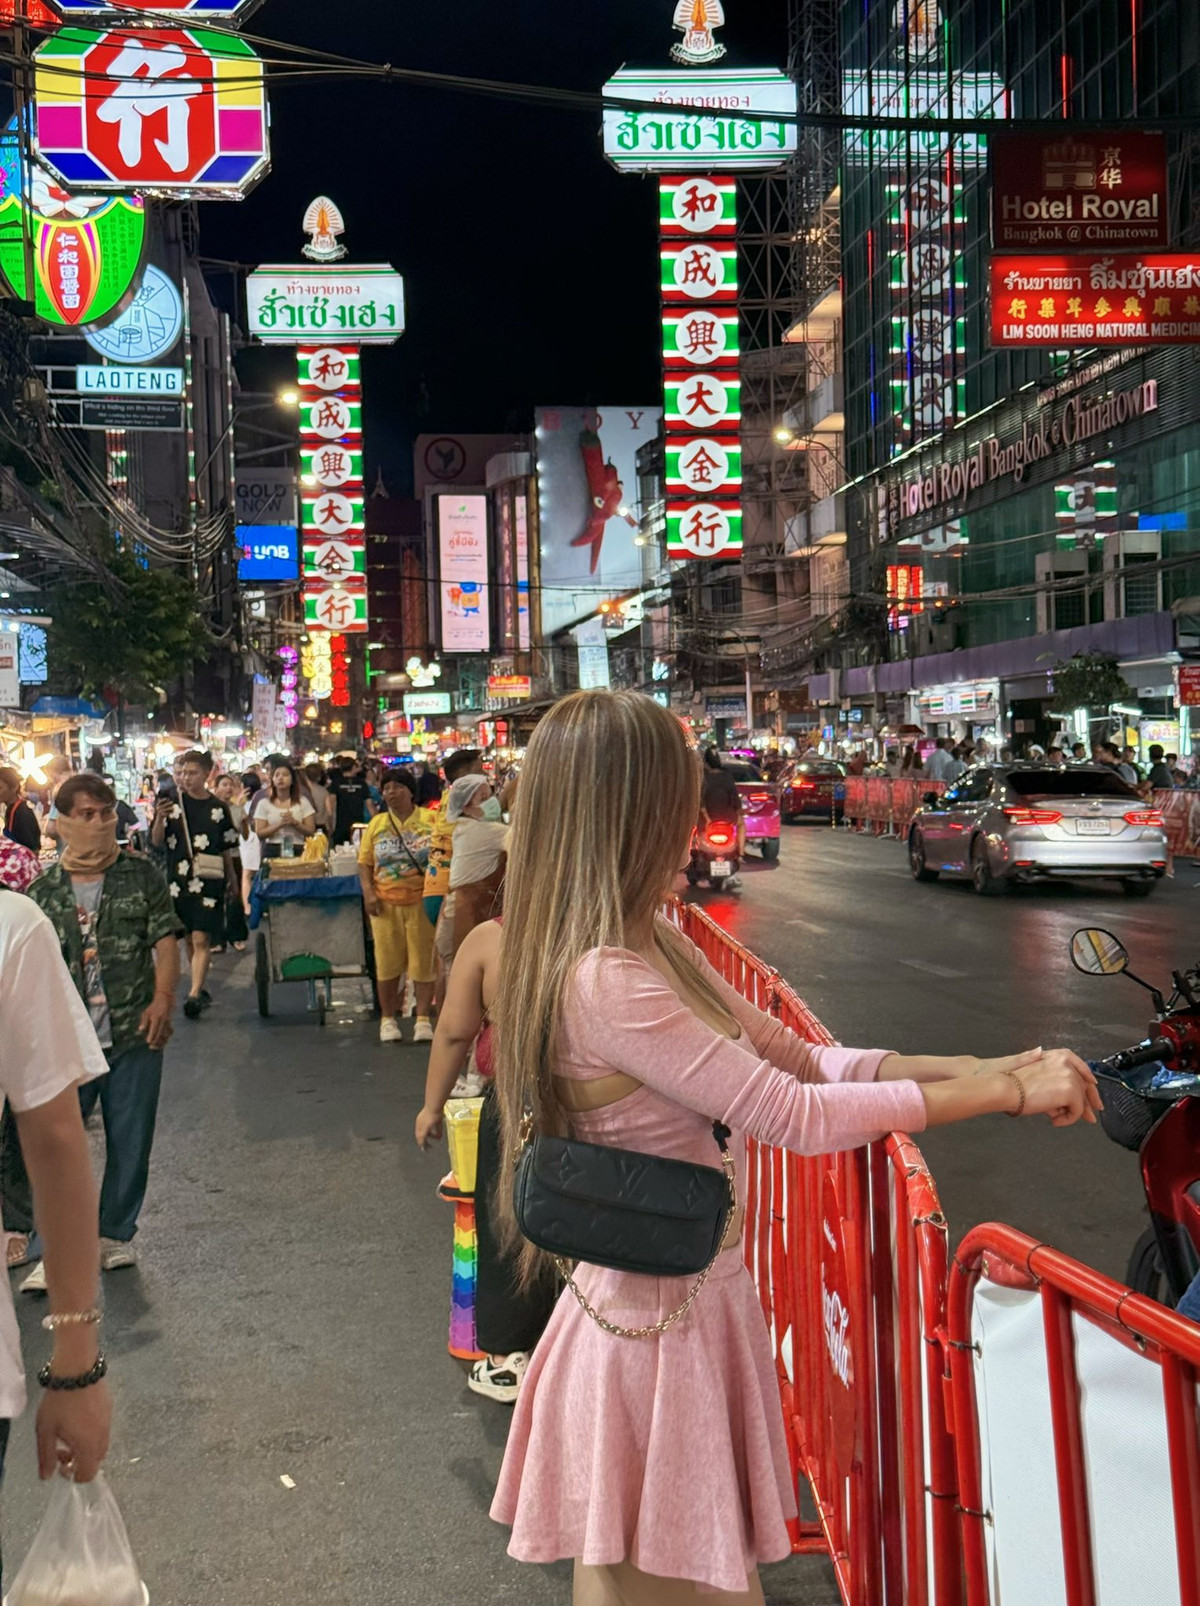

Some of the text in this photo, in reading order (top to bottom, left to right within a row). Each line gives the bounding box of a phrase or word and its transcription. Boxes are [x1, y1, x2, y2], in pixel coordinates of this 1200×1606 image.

[96, 38, 203, 173] 行
[1002, 193, 1159, 220] Hotel Royal
[1003, 225, 1159, 244] Bangkok @ Chinatown
[286, 280, 361, 295] ห้างขายทอง
[1003, 270, 1082, 291] ร้านขายยา
[257, 288, 396, 328] ฮั่วเซ่งเฮง
[1002, 324, 1024, 339] LIM
[1026, 324, 1059, 339] SOON
[1061, 323, 1094, 339] HENG
[1096, 322, 1150, 338] NATURAL
[84, 370, 176, 390] LAOTENG
[900, 465, 938, 519] Hotel
[941, 442, 985, 501] Royal
[990, 412, 1050, 483] Bangkok
[1063, 378, 1158, 446] Chinatown
[236, 483, 287, 499] GOLD
[243, 499, 282, 512] NOW
